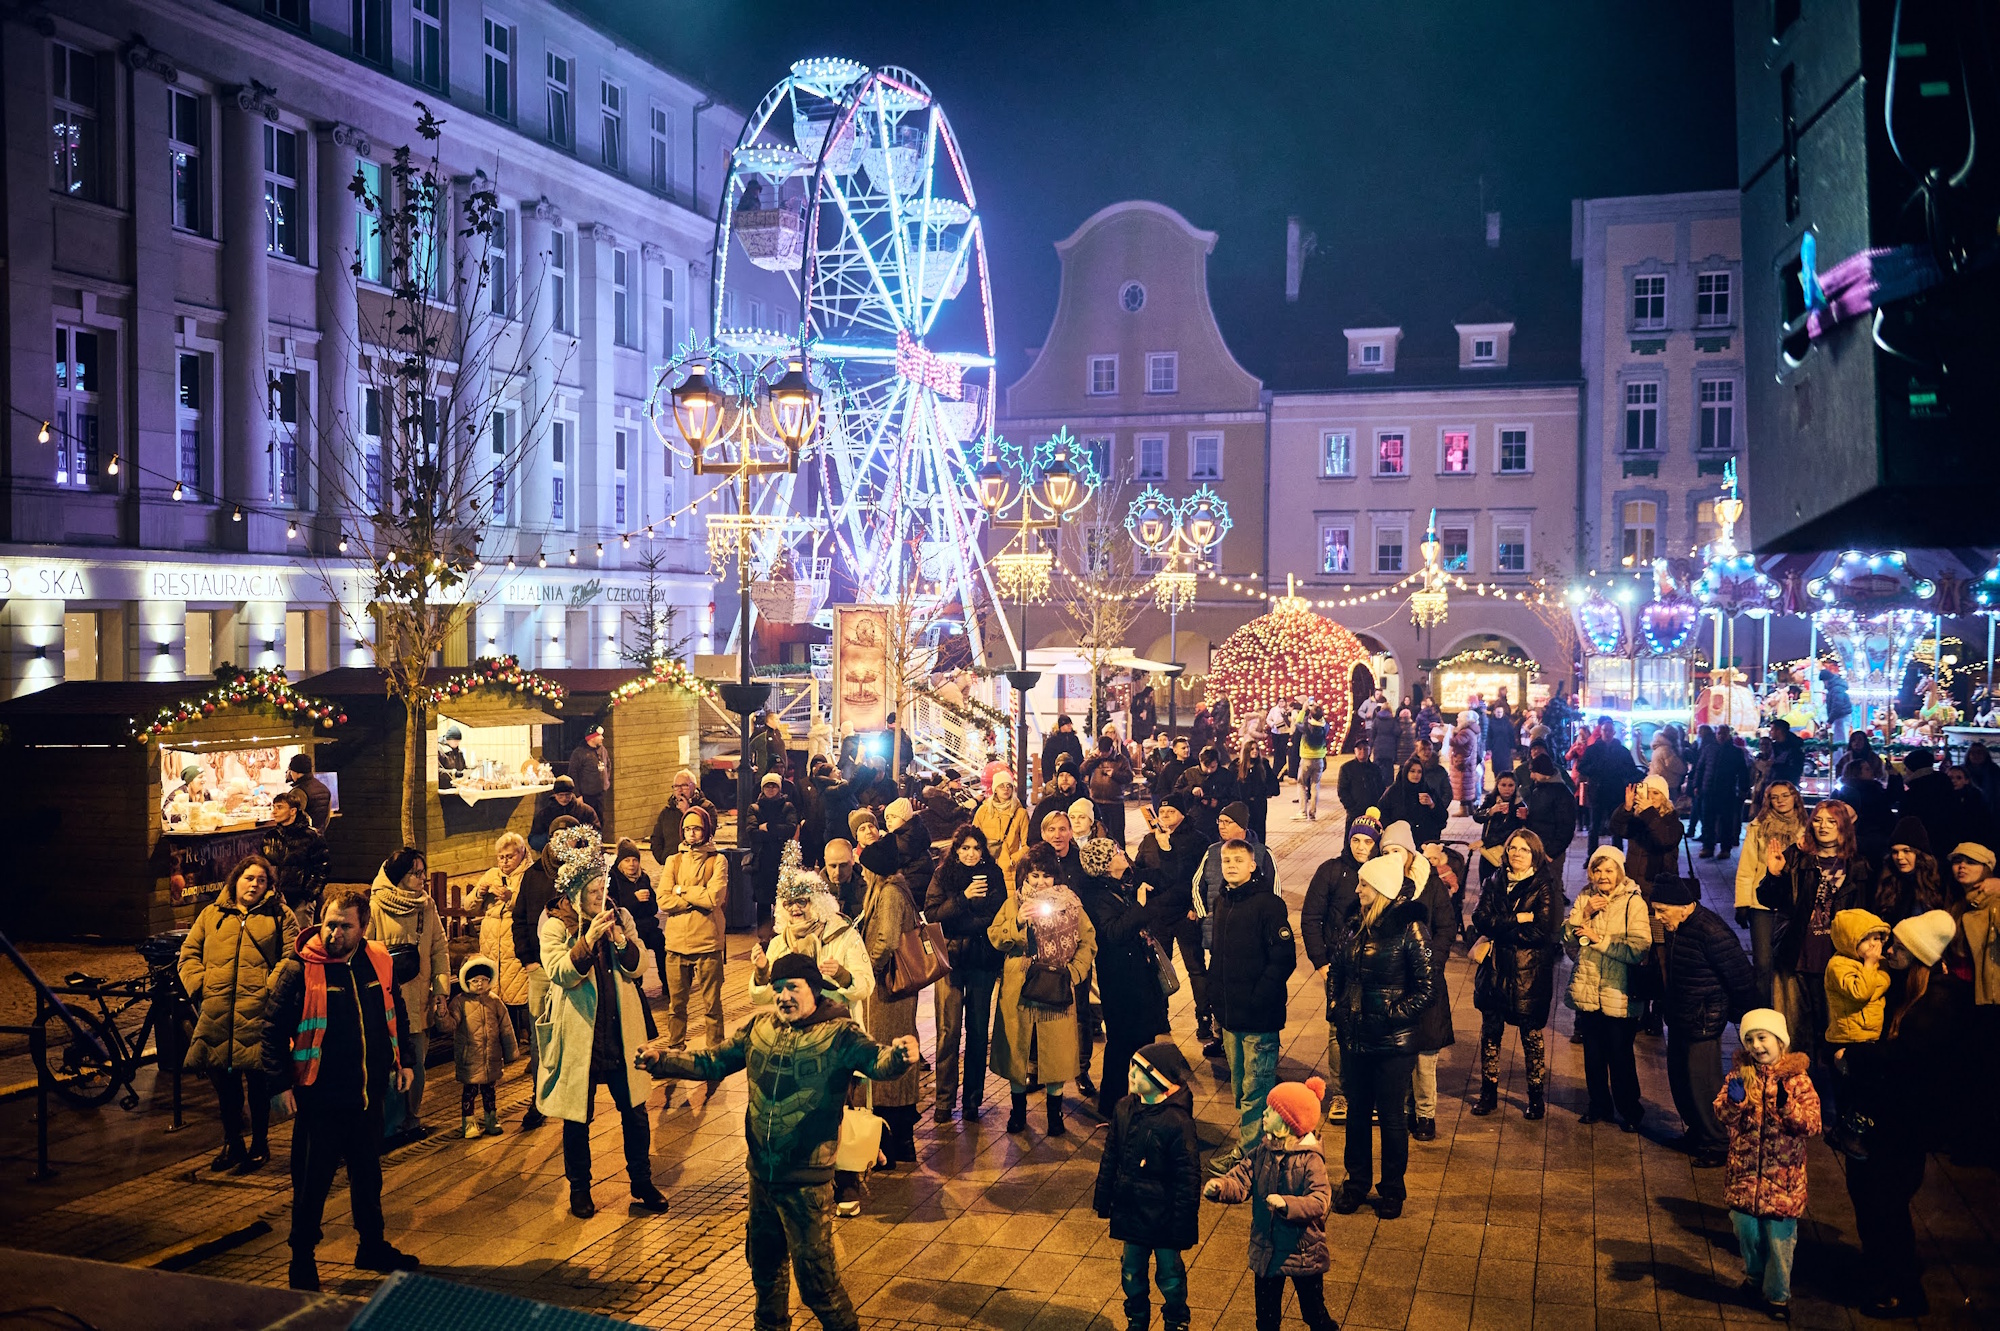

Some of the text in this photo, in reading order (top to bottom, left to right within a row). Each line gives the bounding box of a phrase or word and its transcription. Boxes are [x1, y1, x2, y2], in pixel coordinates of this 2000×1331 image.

[0, 568, 85, 595] BSKA
[153, 573, 284, 596] RESTAURACJA
[509, 585, 564, 601] PIJALNIA
[606, 587, 666, 602] CZEKOLADY
